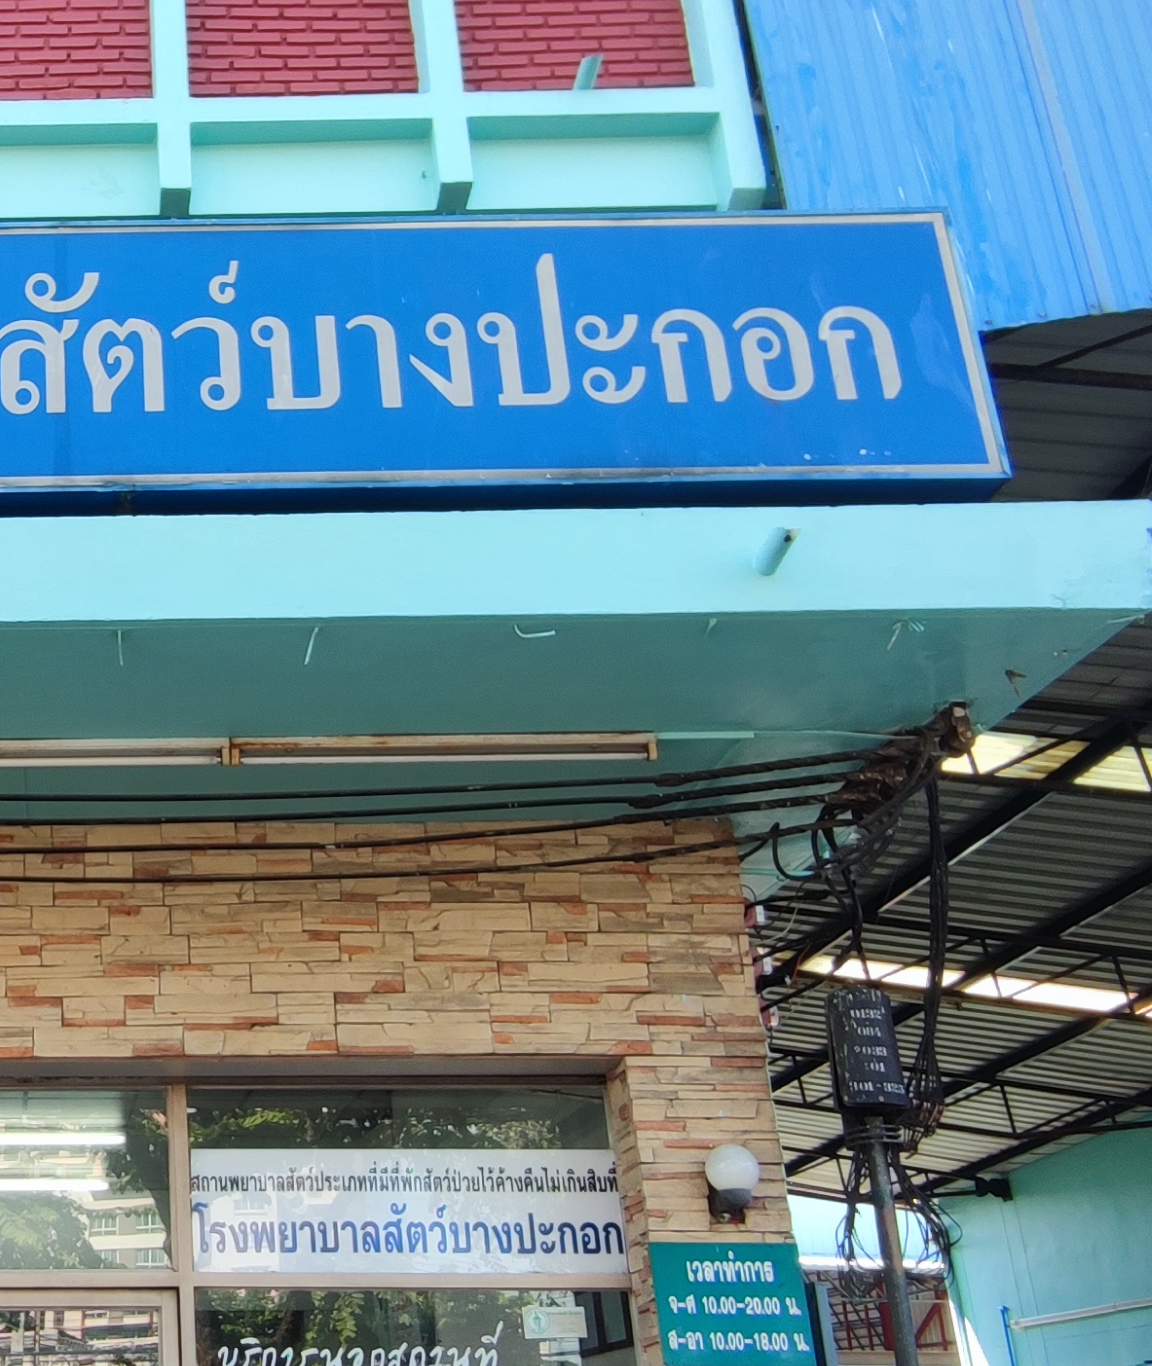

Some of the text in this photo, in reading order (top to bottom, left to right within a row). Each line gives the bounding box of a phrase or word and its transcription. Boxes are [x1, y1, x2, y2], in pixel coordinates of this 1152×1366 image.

[190, 1161, 620, 1193] สถานพยาบาลสัตว์ประเภทที่มีที่พักสัตว์ป่วยไว้ค้างคืนไม่เกินสิบที่
[191, 1202, 625, 1255] โรงพยาบาลสัตว์บางปะกอก
[685, 1250, 775, 1283] เวลาทำการ
[701, 1295, 781, 1316] 10.00-20.00
[784, 1296, 803, 1316] น.
[708, 1331, 789, 1352] 10.00-18.00
[792, 1332, 811, 1352] น.
